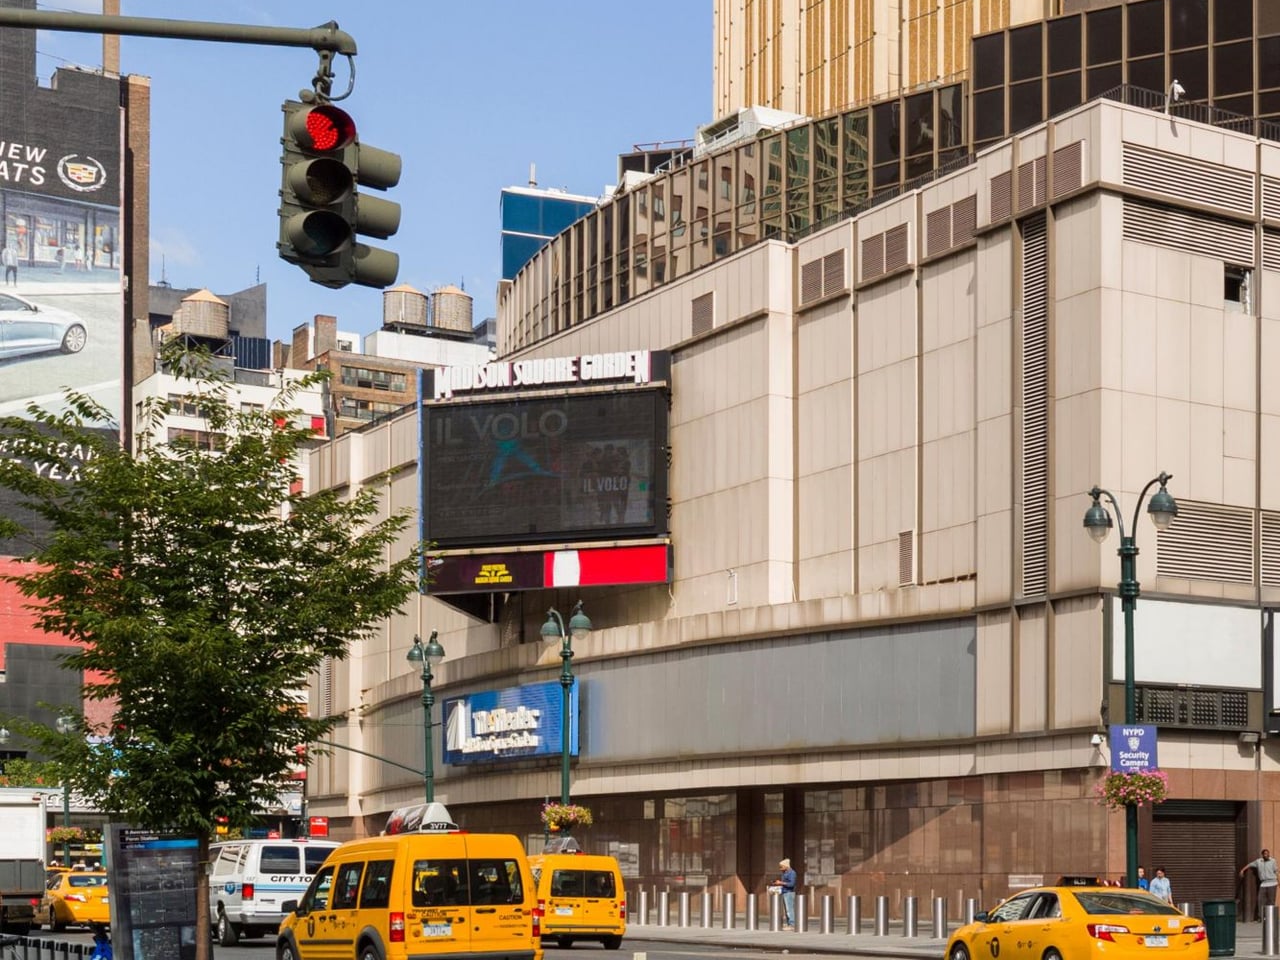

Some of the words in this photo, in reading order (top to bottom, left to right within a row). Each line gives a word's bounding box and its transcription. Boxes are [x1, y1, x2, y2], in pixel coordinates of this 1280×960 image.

[434, 362, 511, 400] MADISON
[513, 357, 579, 387] SQUARE
[580, 350, 651, 385] GARDEN
[436, 417, 464, 445] IL
[470, 409, 568, 441] VOLO
[597, 477, 628, 491] VOLO
[1123, 728, 1145, 736] NYPD
[1119, 751, 1150, 760] Security
[271, 875, 297, 883] CITY
